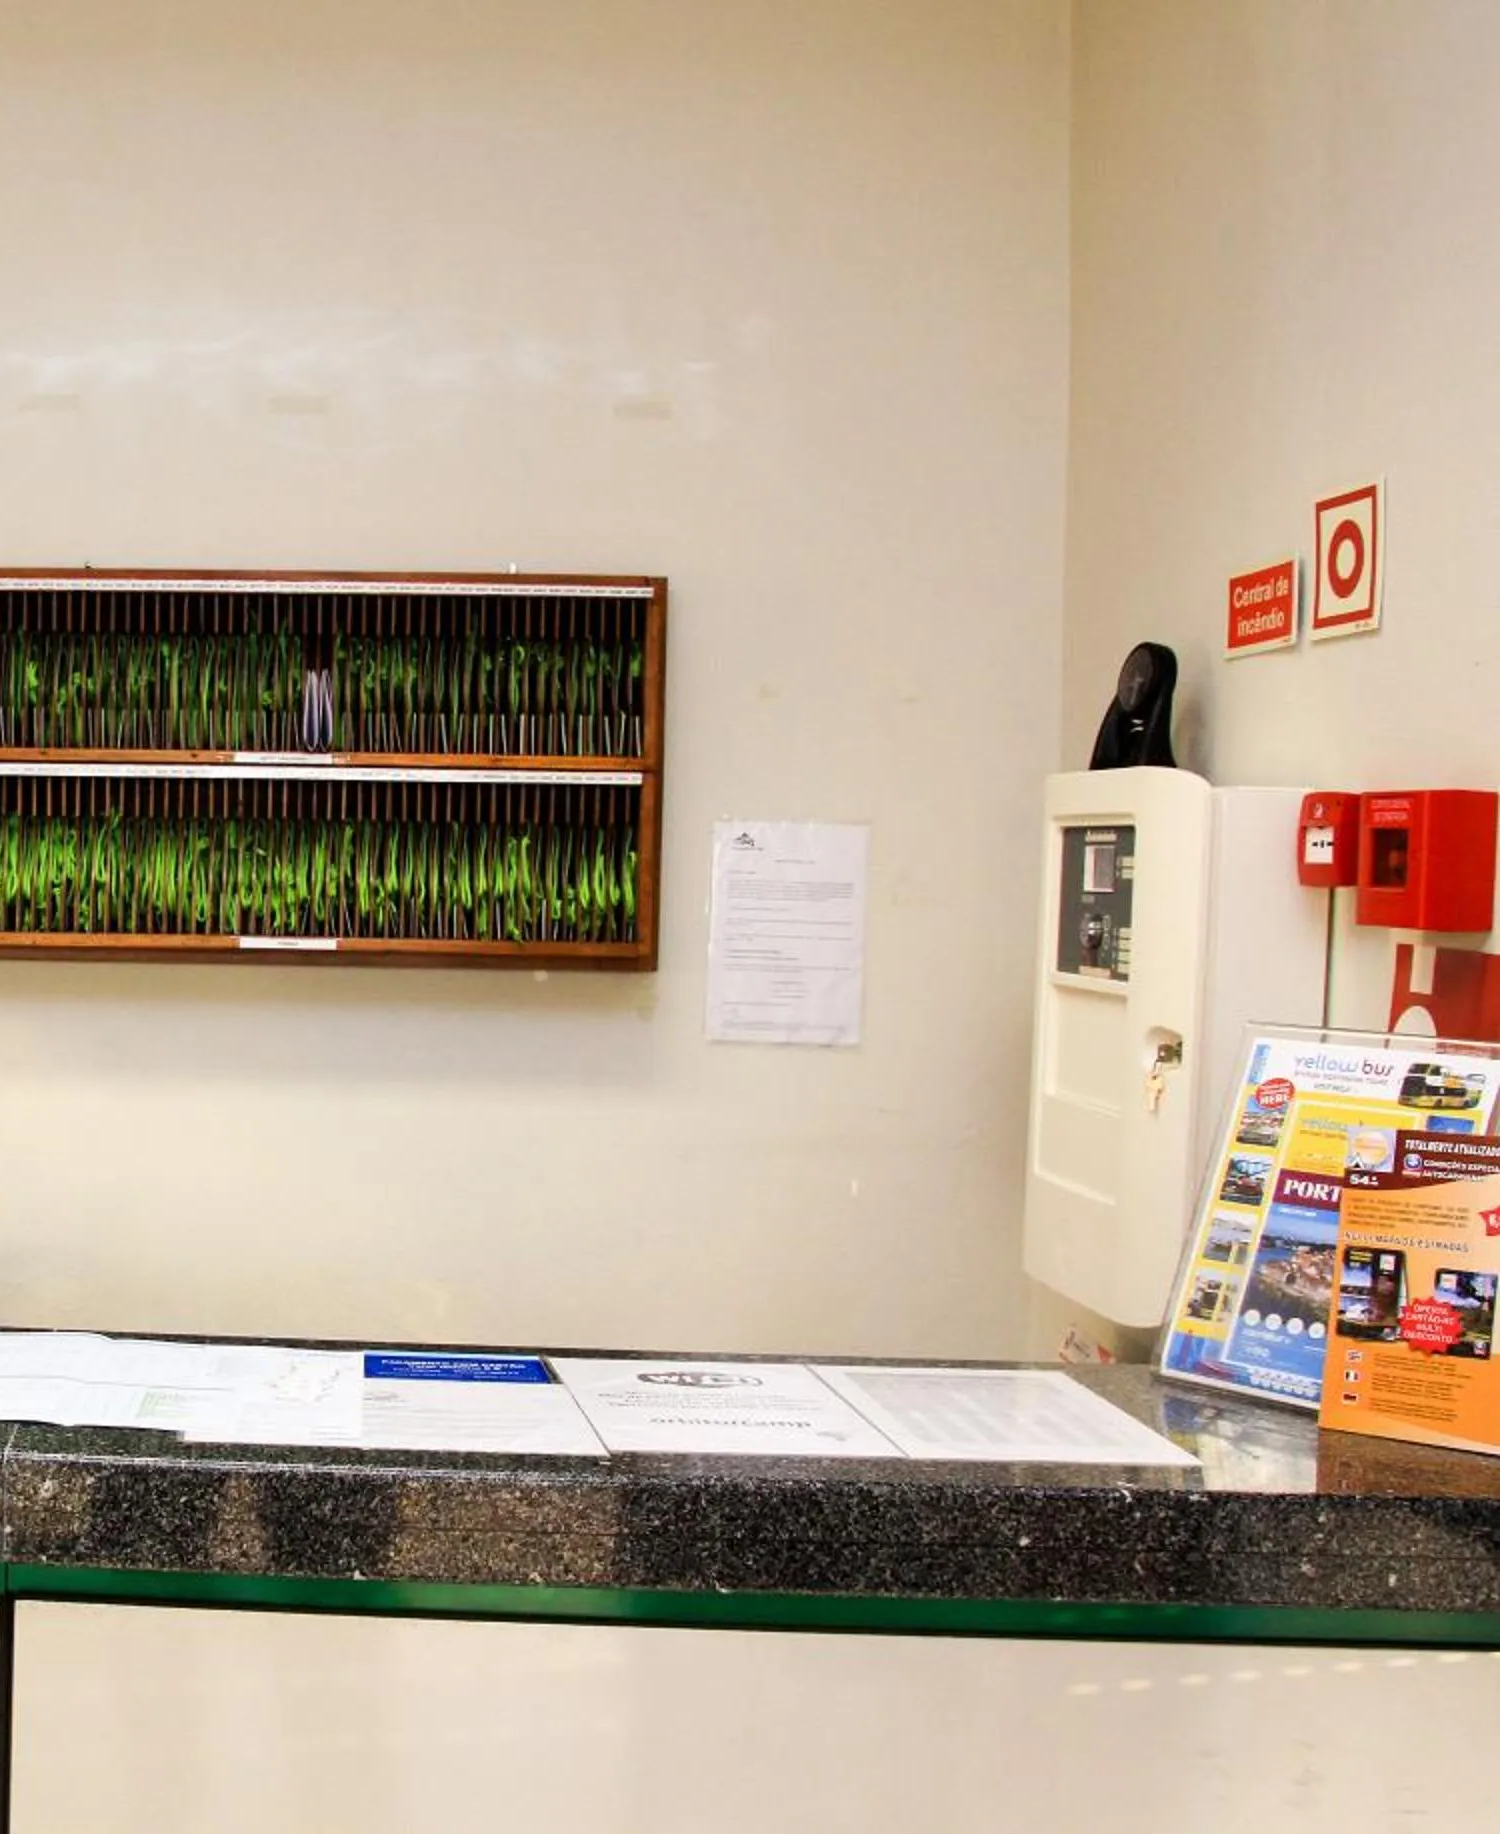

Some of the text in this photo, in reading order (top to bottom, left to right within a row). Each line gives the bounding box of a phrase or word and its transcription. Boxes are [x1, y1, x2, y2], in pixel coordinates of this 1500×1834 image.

[1233, 574, 1289, 609] Central de
[1237, 607, 1285, 637] incêndio
[1293, 1051, 1395, 1077] yellow bus
